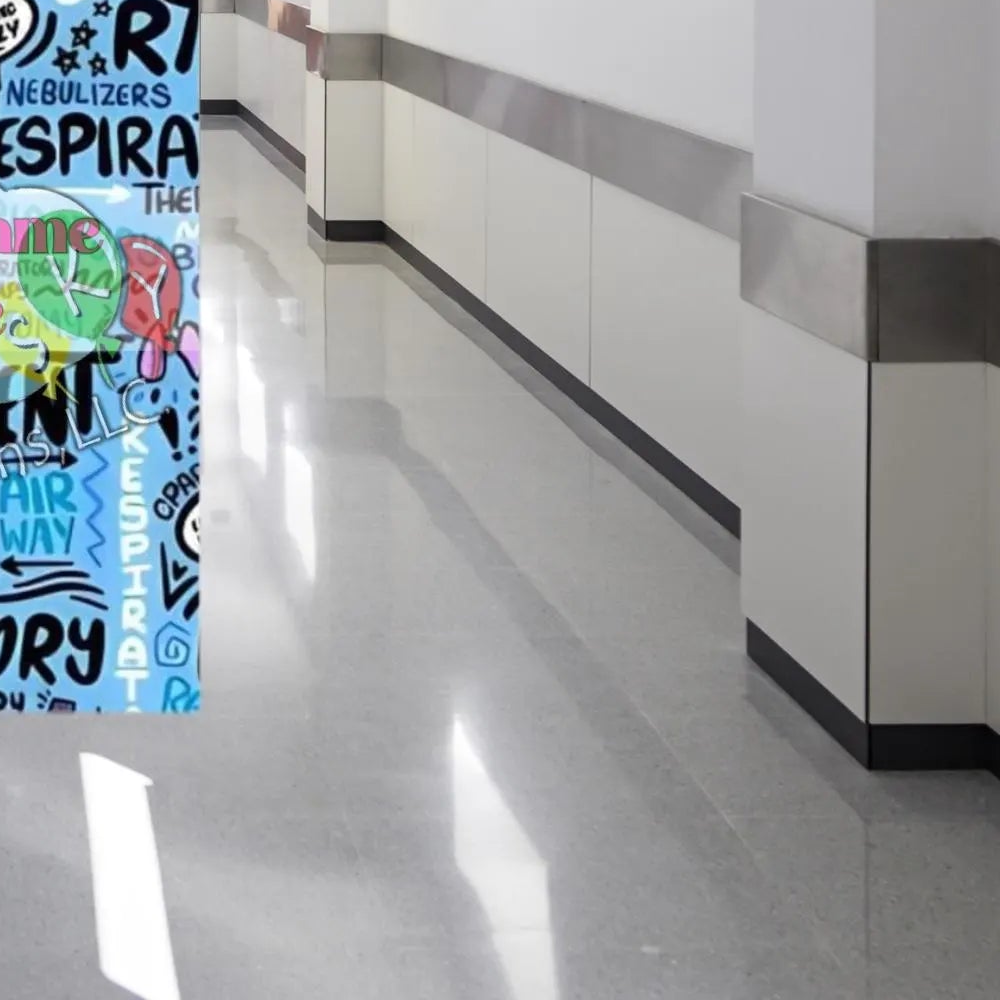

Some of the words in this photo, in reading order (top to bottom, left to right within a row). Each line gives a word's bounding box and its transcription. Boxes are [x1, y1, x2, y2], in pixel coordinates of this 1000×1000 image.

[6, 79, 172, 108] NEBULIZERS
[132, 182, 200, 215] THE
[0, 469, 77, 514] AIR
[0, 517, 75, 555] WAY
